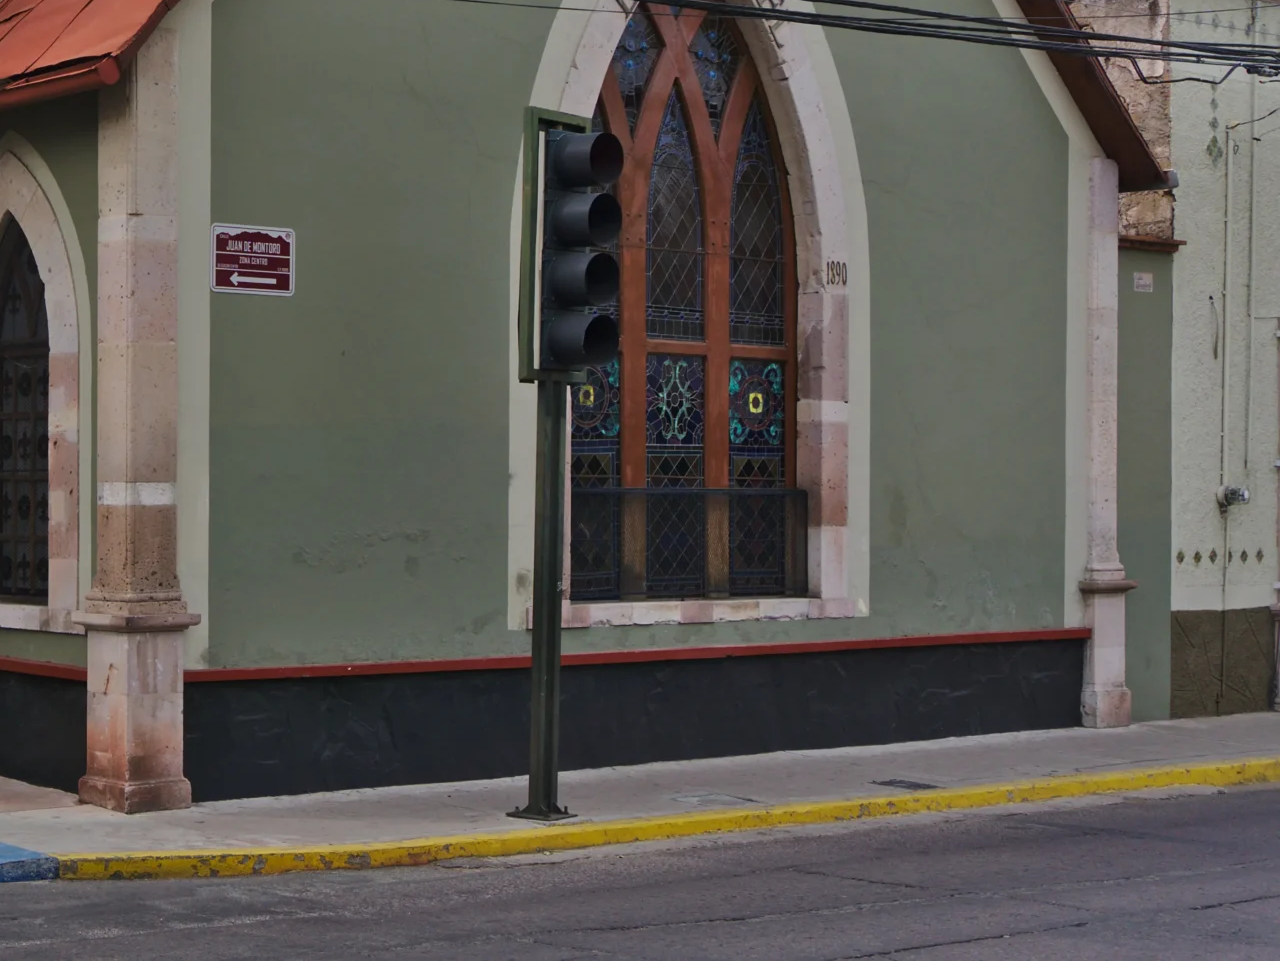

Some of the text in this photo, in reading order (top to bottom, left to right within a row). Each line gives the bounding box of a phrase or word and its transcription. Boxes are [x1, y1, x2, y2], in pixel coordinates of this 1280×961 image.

[226, 240, 281, 254] JUAN DE MONTORO
[239, 256, 268, 266] ZONA CENTRO
[826, 260, 848, 286] 1890
